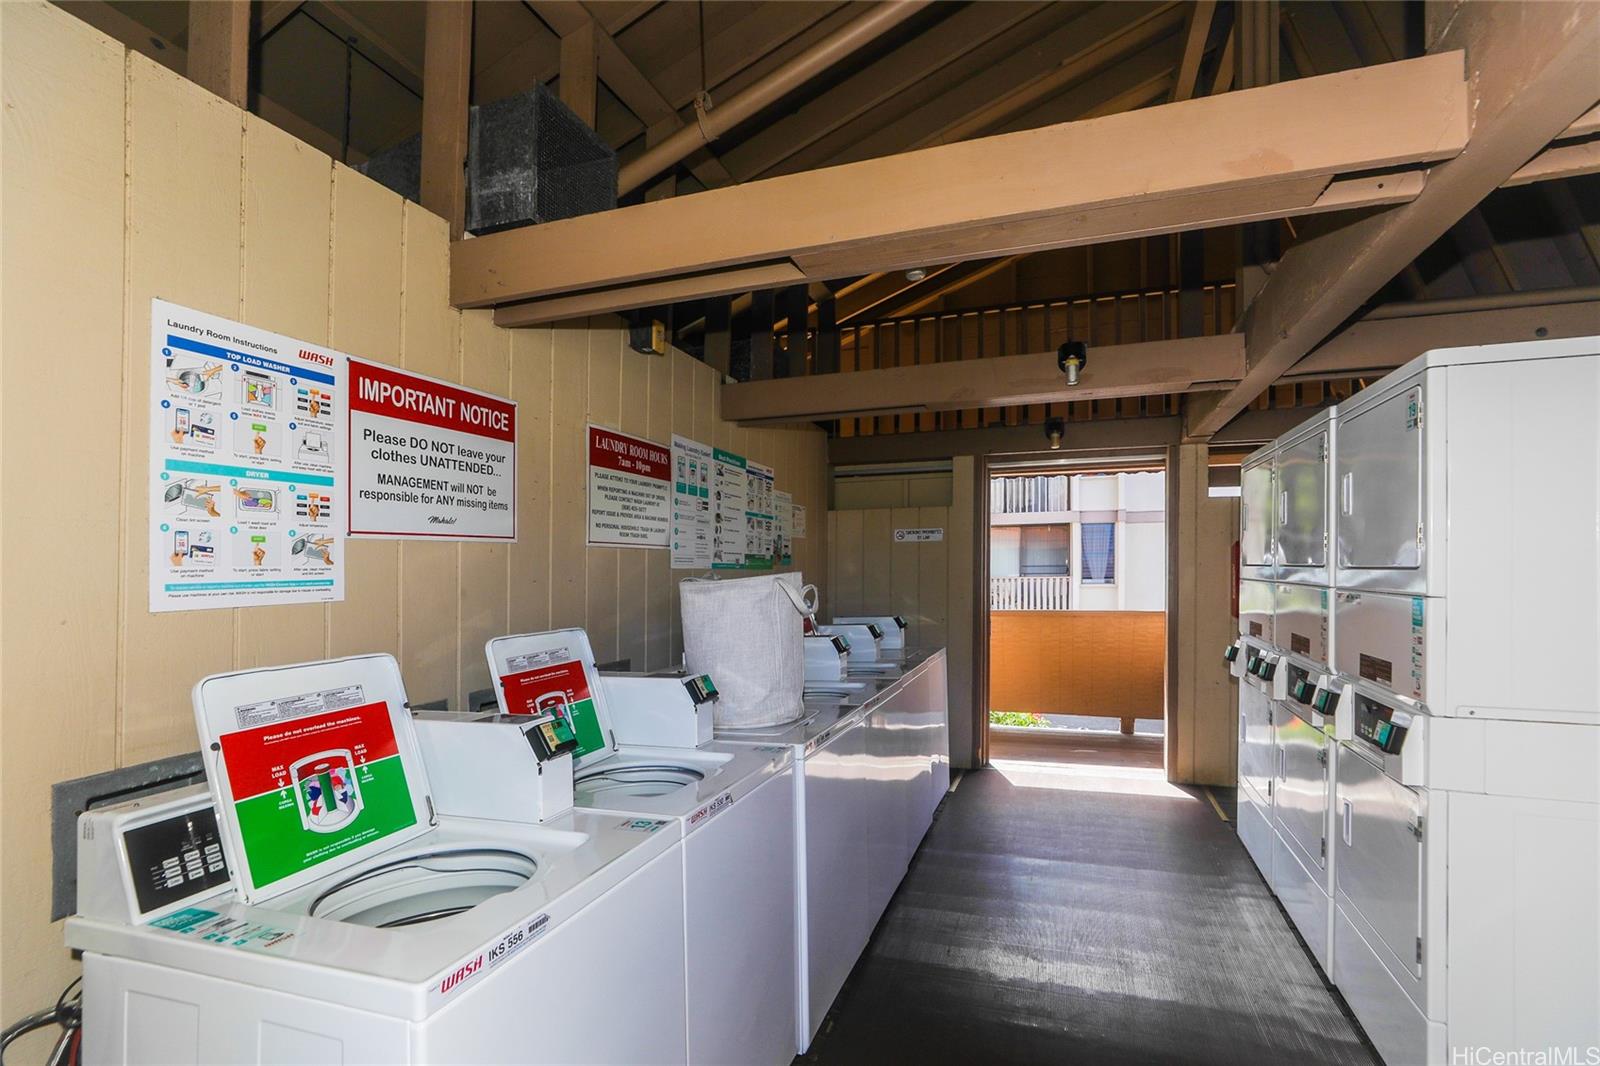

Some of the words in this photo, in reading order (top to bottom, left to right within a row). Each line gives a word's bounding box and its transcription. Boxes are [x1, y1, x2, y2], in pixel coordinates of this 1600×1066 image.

[167, 319, 204, 336] Laundry
[206, 329, 231, 342] Room
[232, 336, 278, 354] Instructions
[226, 352, 241, 361] TOP
[242, 356, 262, 366] LOAD
[263, 361, 291, 373] WASHER
[298, 349, 334, 367] WASH
[359, 376, 456, 419] IMPORTANT
[460, 402, 509, 432] NOTICE
[363, 428, 407, 447] Please
[410, 437, 428, 450] DO
[431, 441, 455, 455] NOT
[458, 445, 484, 460] leave
[485, 453, 506, 465] your
[595, 435, 629, 455] LAUNDRY
[629, 445, 649, 460] ROOM
[649, 450, 669, 465] HOURS
[246, 470, 269, 479] DRYER
[371, 449, 417, 465] clothes
[420, 455, 502, 477] UNATTENDED...
[618, 456, 632, 468] 7am
[636, 460, 651, 473] 10pm
[377, 473, 449, 492] MANAGEMENT
[451, 482, 465, 493] will
[466, 484, 484, 495] NOT
[487, 486, 497, 497] be
[359, 489, 419, 503] responsible
[421, 493, 434, 505] for
[436, 495, 455, 506] ANY
[457, 497, 487, 511] missing
[488, 501, 509, 511] items
[263, 733, 284, 742] Please
[303, 723, 326, 733] overload
[336, 716, 361, 725] machines.
[354, 748, 368, 756] LOAD
[271, 764, 284, 772] MAX
[271, 770, 287, 779] LOAD
[441, 955, 483, 994] WASH
[488, 943, 506, 962] IKS
[508, 930, 524, 949] 556
